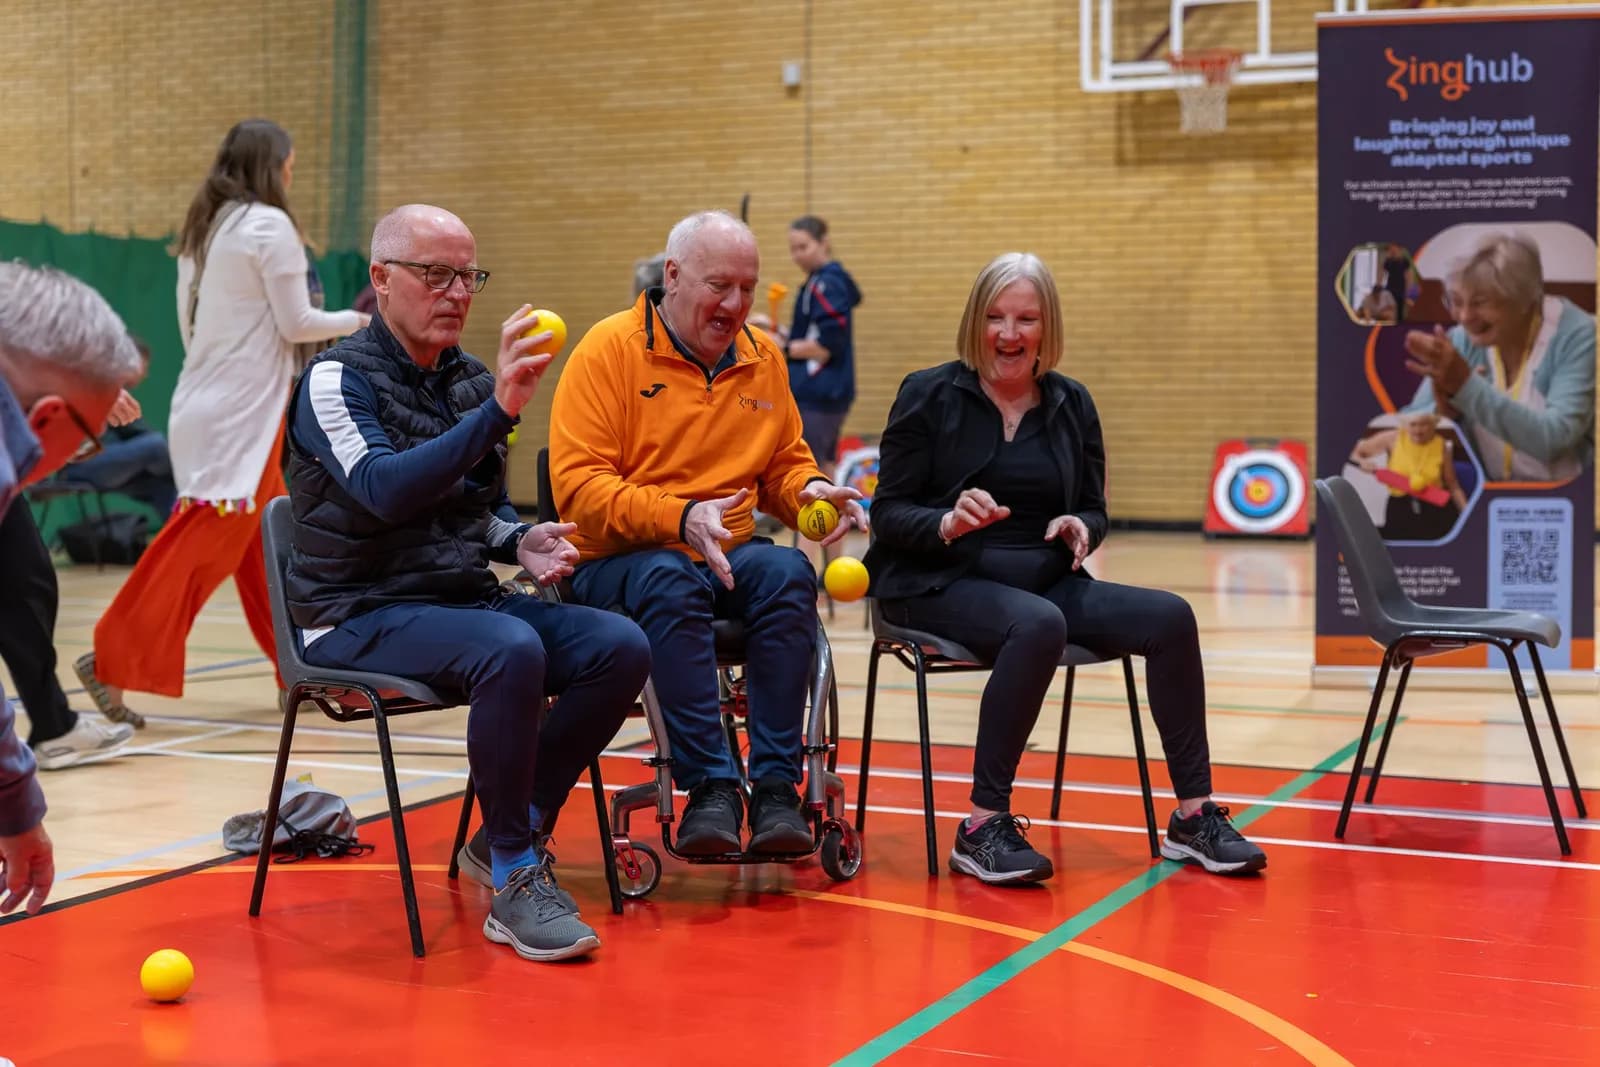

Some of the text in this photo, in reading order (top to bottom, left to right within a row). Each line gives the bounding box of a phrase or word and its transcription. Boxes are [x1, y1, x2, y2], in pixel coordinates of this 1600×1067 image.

[1389, 115, 1535, 136] Bringing joy and
[1353, 132, 1571, 154] laughter through unique
[1390, 150, 1533, 169] adapted sports
